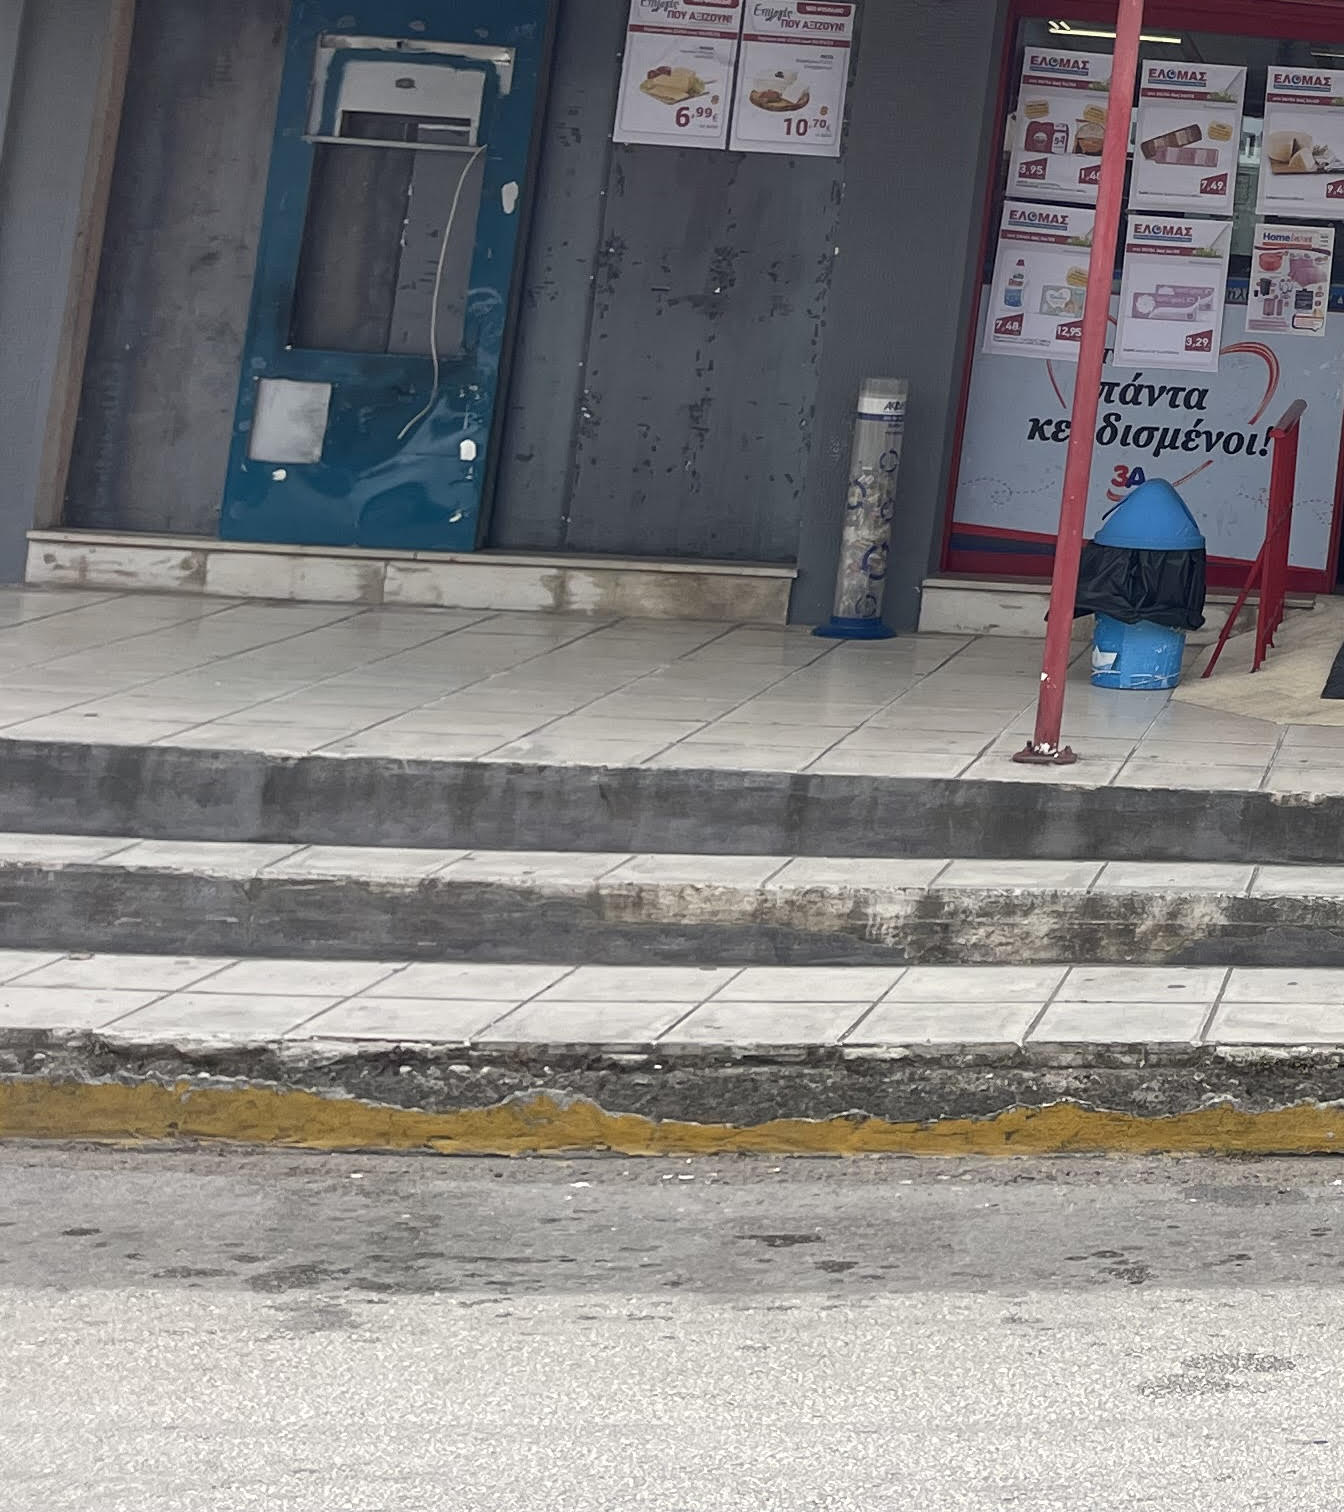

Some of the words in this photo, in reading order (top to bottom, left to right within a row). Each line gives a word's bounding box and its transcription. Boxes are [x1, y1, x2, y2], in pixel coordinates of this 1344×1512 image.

[667, 9, 687, 20] ΠΟΥ
[781, 19, 800, 29] ΠΟΥ
[1099, 373, 1208, 410] πάντα
[1028, 413, 1272, 457] κεδισμένοι!
